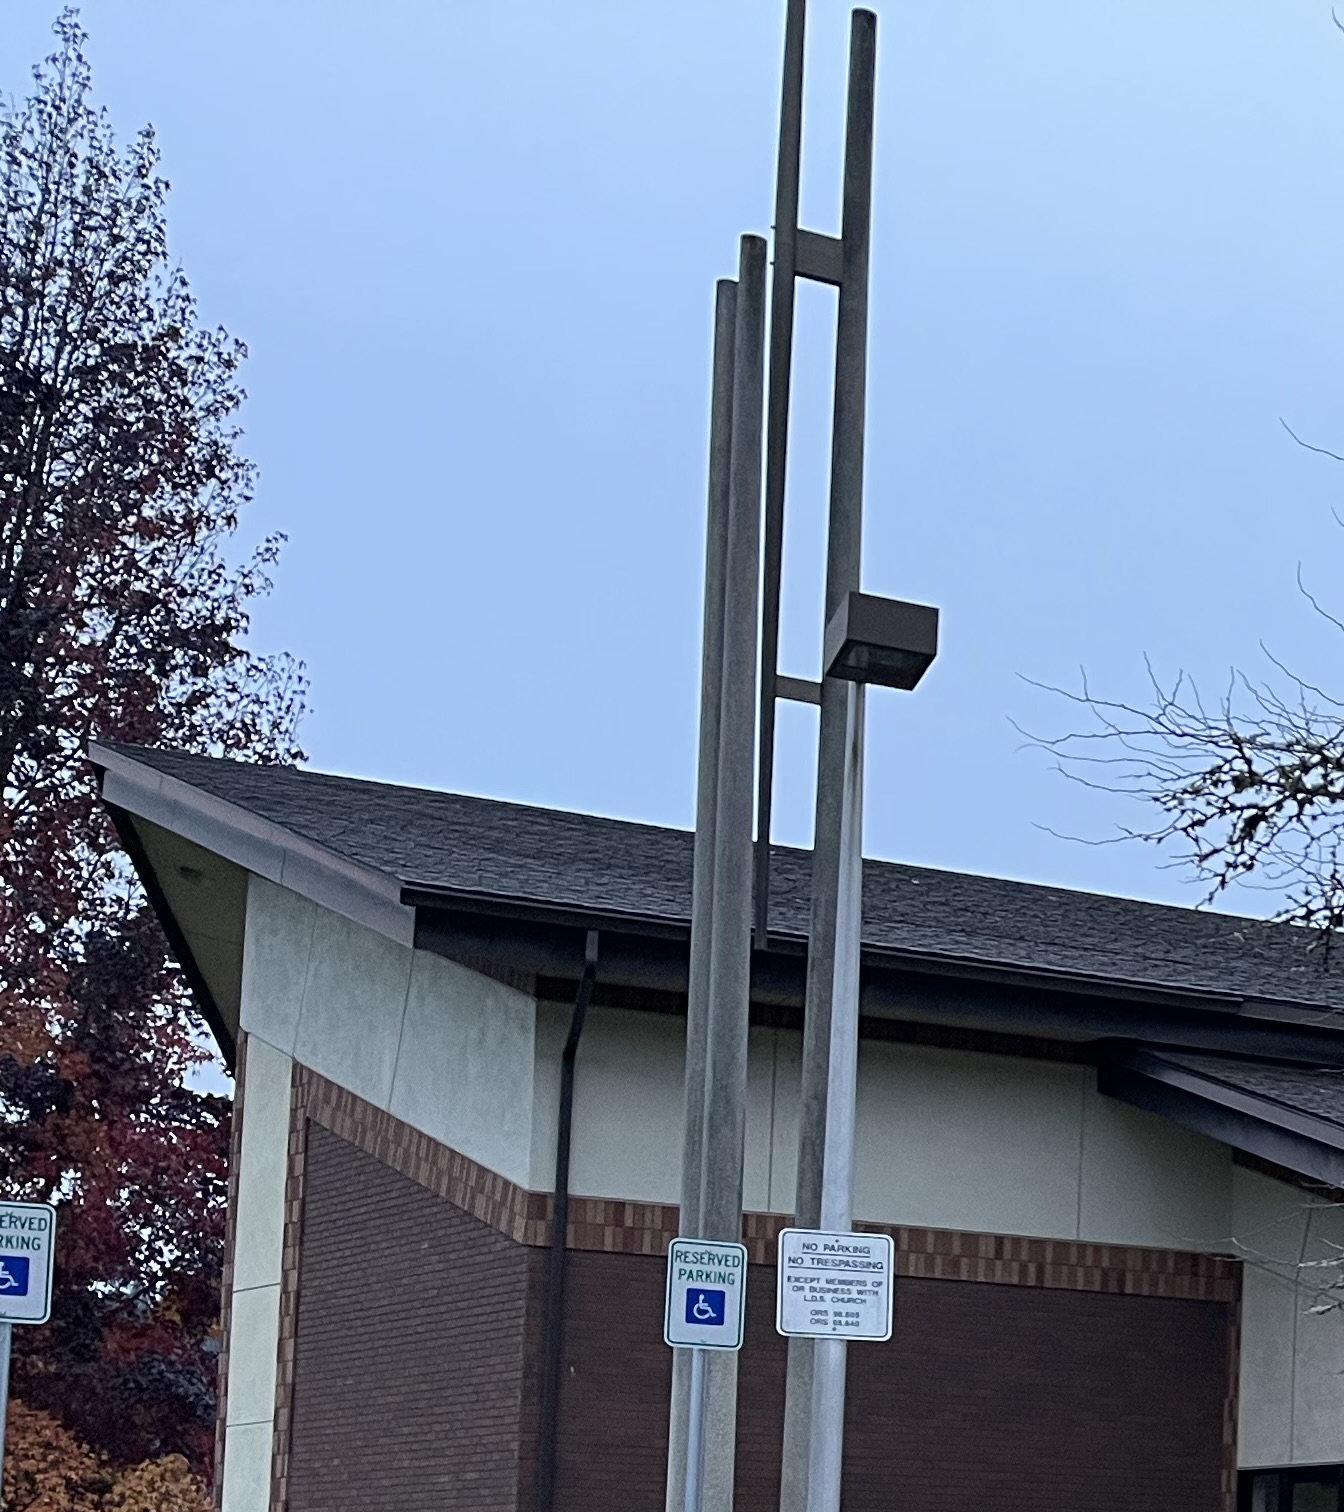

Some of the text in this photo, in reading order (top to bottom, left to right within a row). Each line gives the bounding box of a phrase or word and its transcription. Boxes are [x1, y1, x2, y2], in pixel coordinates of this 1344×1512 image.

[802, 1242, 871, 1254] NO PARKING
[675, 1249, 740, 1268] RESERVED
[787, 1256, 884, 1270] NO TRESPASSING
[678, 1268, 736, 1286] PARKING
[787, 1275, 884, 1288] EXCEPT MEMBERS OF
[809, 1285, 852, 1295] BUSINESS
[856, 1289, 879, 1297] WITH
[830, 1296, 867, 1305] CHURCH
